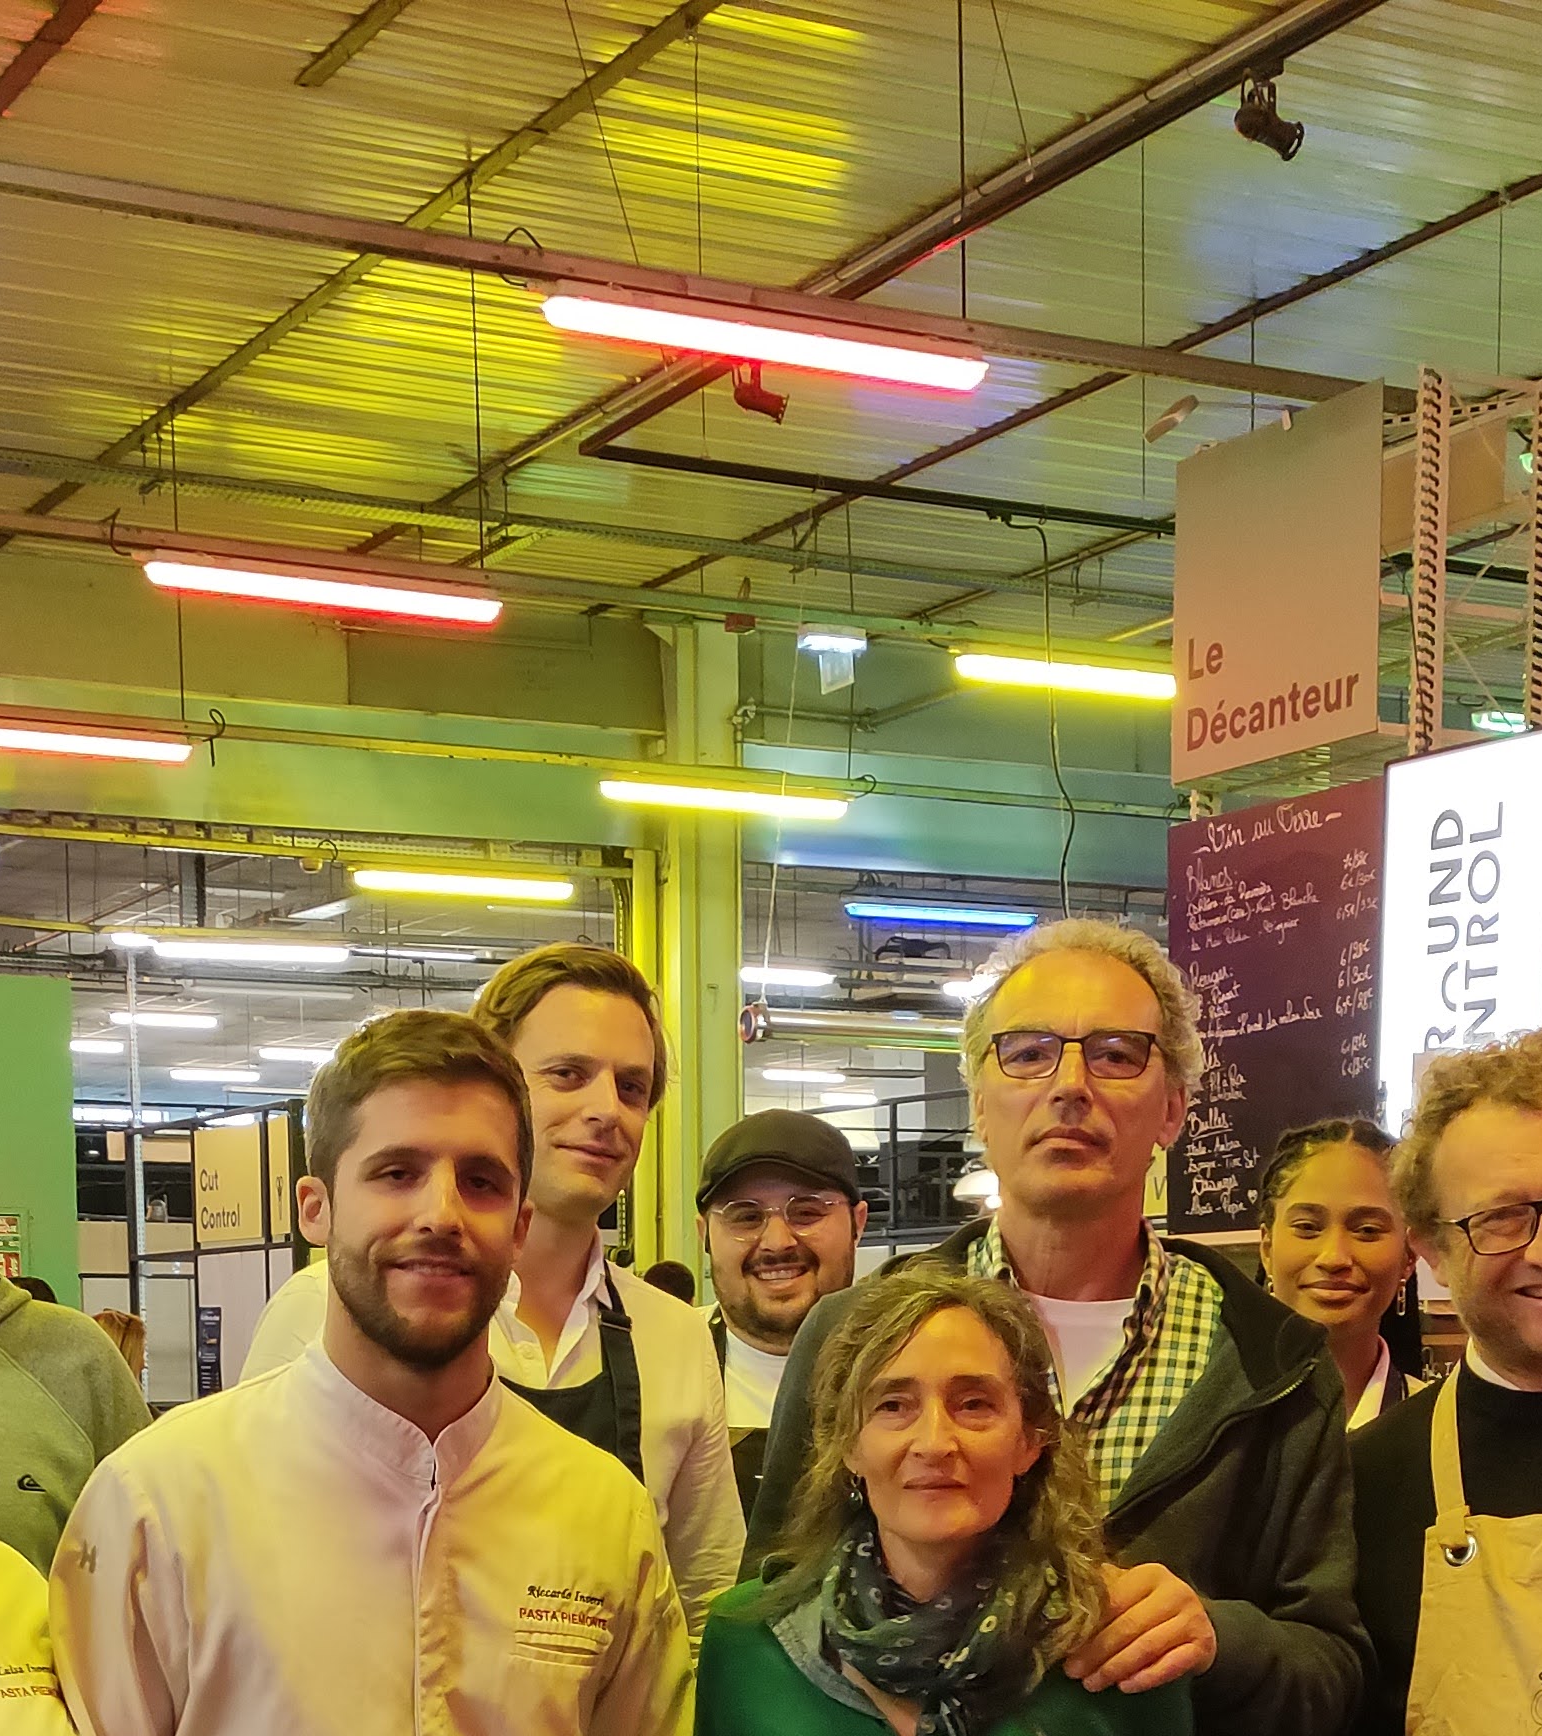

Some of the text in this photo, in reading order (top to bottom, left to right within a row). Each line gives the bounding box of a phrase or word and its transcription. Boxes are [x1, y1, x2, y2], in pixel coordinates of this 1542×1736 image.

[1187, 639, 1223, 681] Le
[1186, 670, 1359, 751] Décanteur
[1252, 818, 1273, 841] au
[1424, 809, 1463, 1052] ROUND
[1463, 801, 1503, 1045] NTROL
[200, 1168, 219, 1191] Cut
[200, 1203, 241, 1230] Control
[527, 1585, 572, 1599] Riccardo
[519, 1607, 608, 1630] PASTA PIEMONTE
